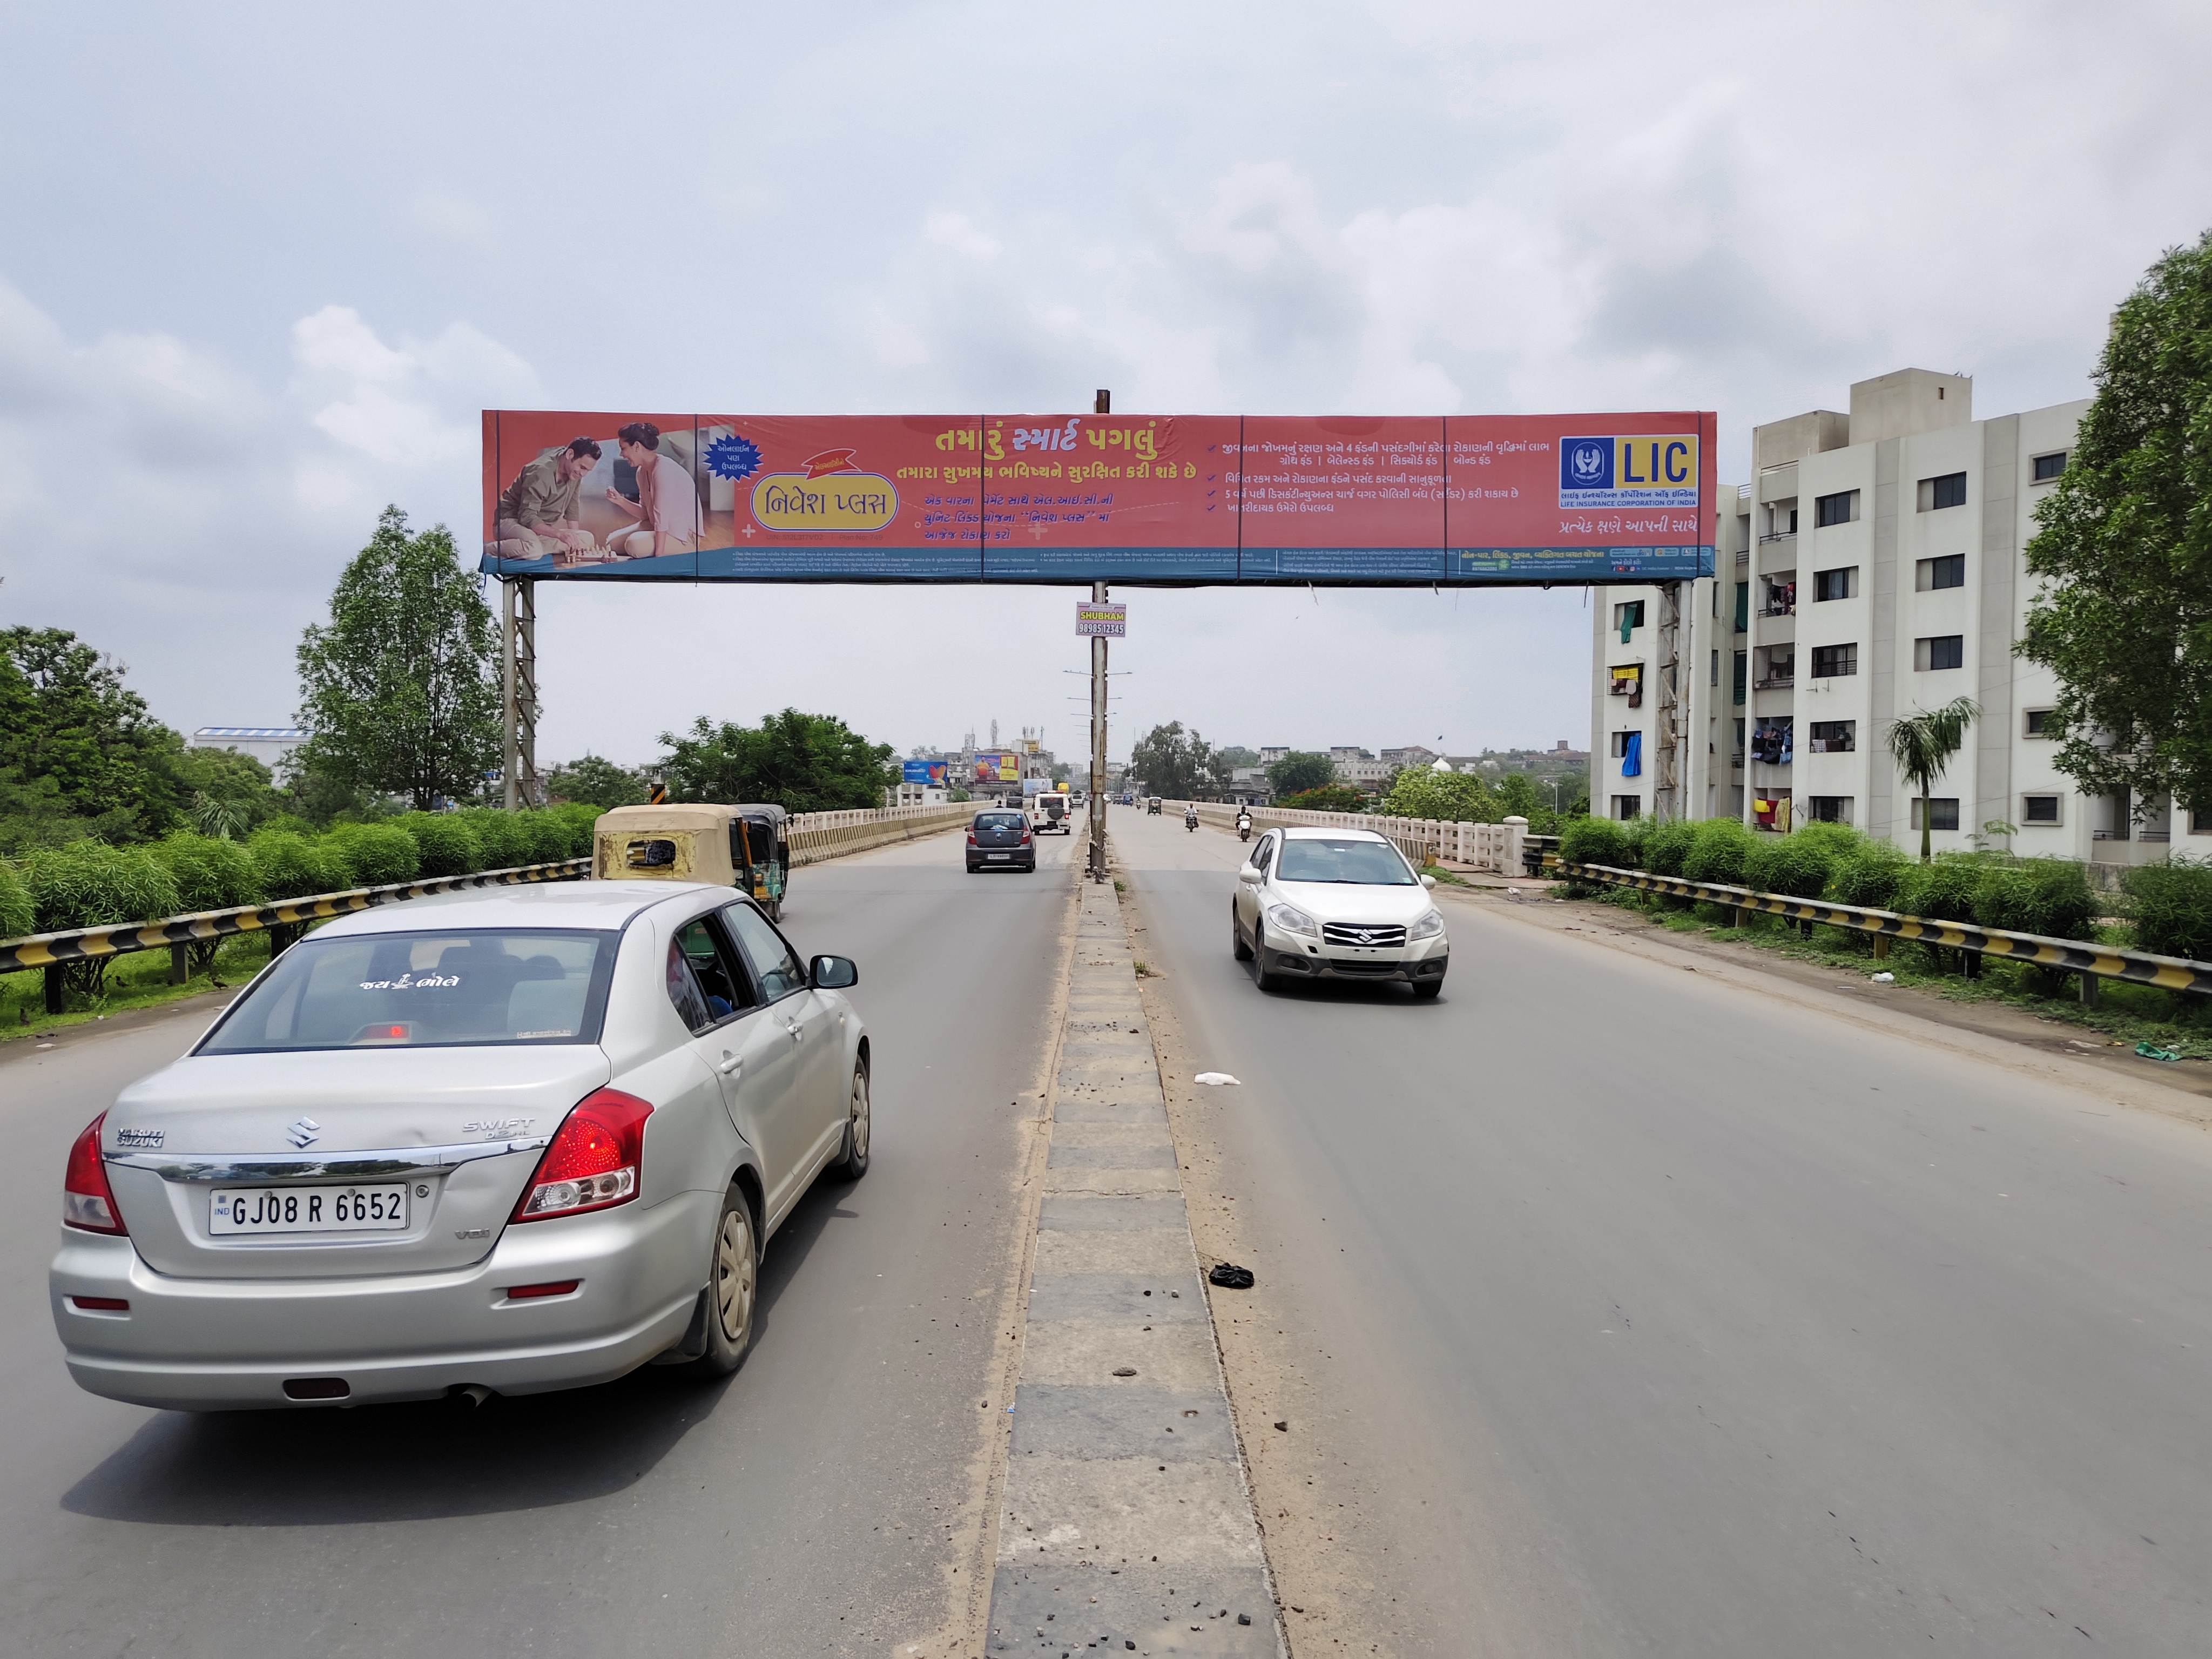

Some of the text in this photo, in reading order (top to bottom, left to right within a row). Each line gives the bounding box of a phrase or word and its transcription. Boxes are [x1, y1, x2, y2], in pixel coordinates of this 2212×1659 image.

[935, 419, 1158, 461] તમારું સ્માર્ટ પગલું
[1298, 444, 1323, 453] રક્ષણ
[1325, 441, 1344, 453] અને
[1346, 443, 1352, 452] 4
[1354, 441, 1379, 453] ફંડની
[1453, 441, 1493, 452] રોકાણની
[1529, 442, 1549, 451] લાભ
[1300, 454, 1312, 466] ફંડ
[1363, 454, 1374, 466] ફંડ
[1426, 454, 1438, 465] ફંડ
[1479, 453, 1491, 464] ફંડ
[1624, 442, 1688, 483] LIC
[896, 461, 1197, 484] તમારા સુખમય ભવિષ્યને સુરક્ષિત કરી શકે છે
[1253, 475, 1270, 483] રકમ
[1273, 473, 1290, 483] અને
[1292, 473, 1328, 483] રોકાણના
[1331, 472, 1350, 483] ફંડને
[1352, 472, 1373, 483] પસંદ
[1375, 473, 1406, 483] કરવાની
[1225, 490, 1231, 498] 5
[1357, 490, 1377, 498] વગર
[1379, 488, 1410, 498] પોલિસી
[1412, 488, 1427, 498] બંધ
[1468, 488, 1482, 498] કરી
[1485, 490, 1508, 498] શકાય
[1510, 487, 1519, 498] છે
[765, 485, 887, 514] નિવેશ પ્લસ
[925, 494, 942, 506] એક
[946, 497, 974, 505] વારના
[1008, 494, 1029, 505] સાથે
[1300, 504, 1334, 512] ઉપલબ્ધ
[925, 511, 951, 526] યુનિટ
[983, 511, 1016, 523] યોજના
[1559, 516, 1593, 533] પ્રત્યેક
[1625, 515, 1668, 532] આપની
[1673, 515, 1698, 532] સાથે
[994, 528, 1011, 540] કરો
[1080, 611, 1124, 621] SHUBHAM
[1078, 623, 1124, 634] 98985 12345
[359, 976, 460, 990] જય ભોલે
[463, 1117, 535, 1132] SWIFT
[117, 1136, 163, 1148] SUZUKI
[233, 1192, 401, 1225] GJ08 R 6652
